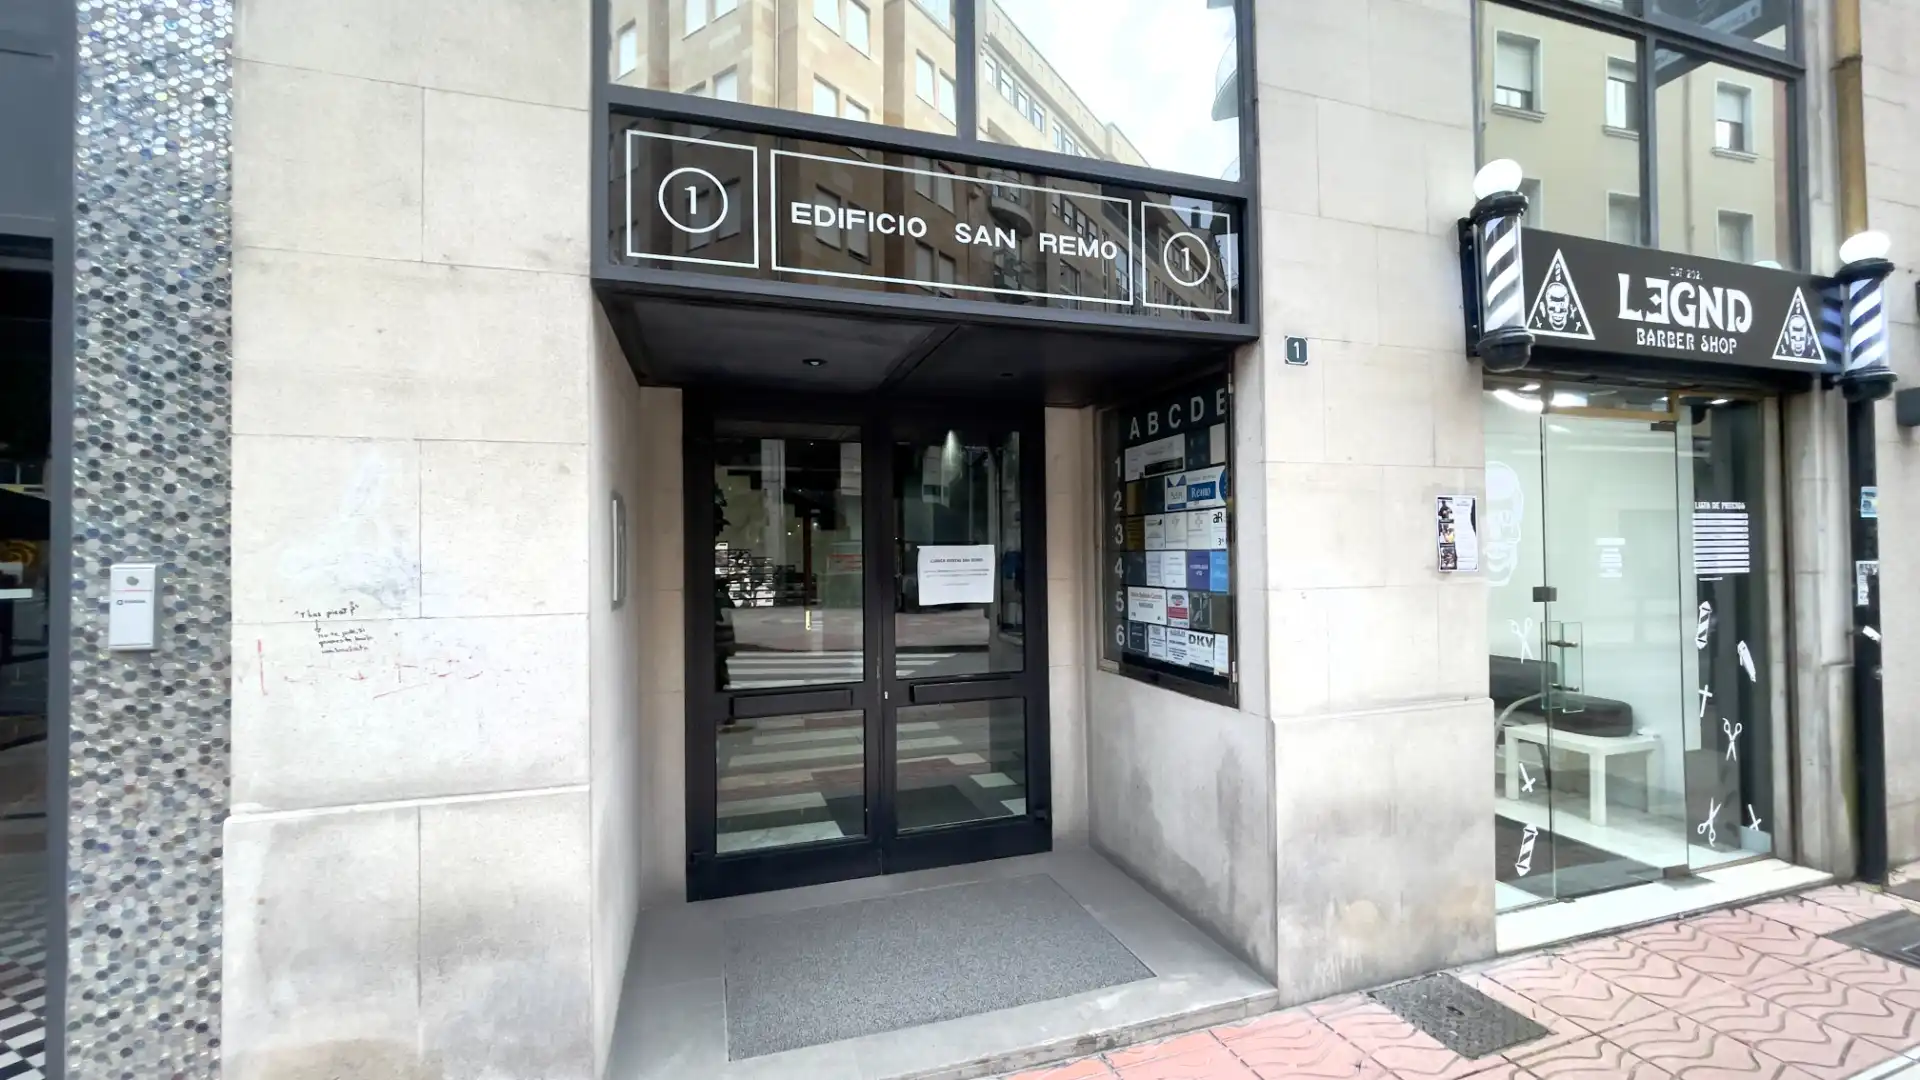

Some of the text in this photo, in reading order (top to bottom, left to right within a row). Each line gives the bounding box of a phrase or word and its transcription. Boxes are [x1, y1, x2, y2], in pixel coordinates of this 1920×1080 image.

[683, 185, 697, 215] 1
[790, 200, 1119, 261] EDIFICIO SAN REMO
[1180, 246, 1191, 272] 1
[1617, 272, 1754, 333] LEGND
[1293, 341, 1300, 359] 1
[1636, 327, 1738, 355] BARBER SHOP
[1129, 388, 1226, 440] A B C D E
[1113, 490, 1123, 512] 2
[1114, 523, 1124, 545] 3
[1114, 557, 1124, 579] 4
[1115, 590, 1125, 612] 5
[1115, 624, 1125, 646] 6
[1188, 633, 1215, 648] DKV
